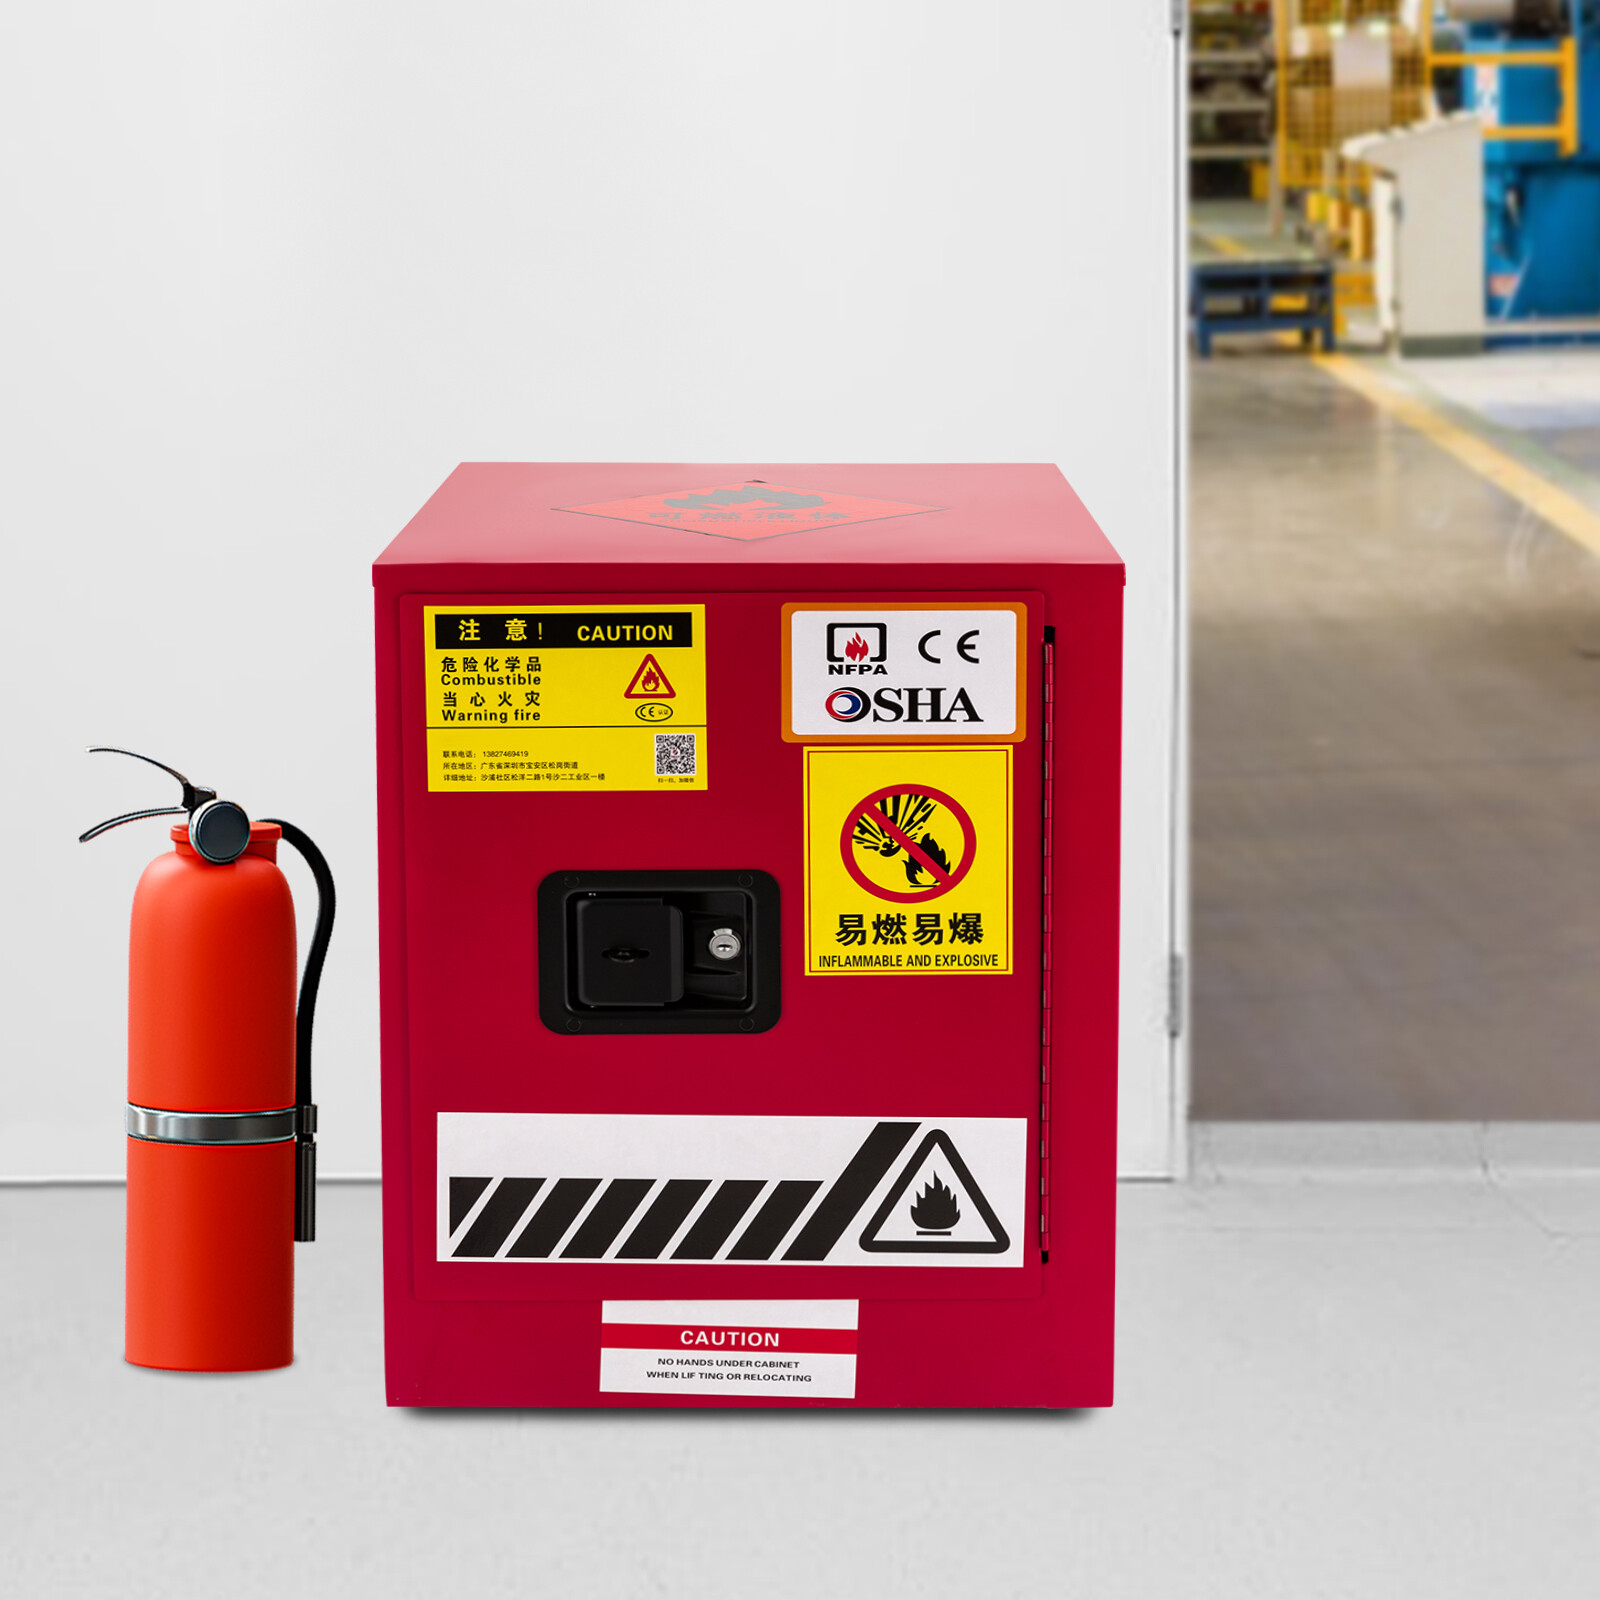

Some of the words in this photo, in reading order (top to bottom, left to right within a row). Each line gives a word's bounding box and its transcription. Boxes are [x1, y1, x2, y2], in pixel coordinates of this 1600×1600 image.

[577, 624, 673, 642] CAUTION
[918, 629, 980, 665] CE
[442, 656, 542, 672] 危险化学品
[828, 663, 888, 675] NFPA
[440, 673, 542, 686] Combustible
[443, 691, 541, 707] 当心火灾
[825, 686, 984, 722] OSHA
[442, 709, 508, 724] Warning
[514, 709, 541, 721] fire
[835, 912, 985, 947] 易燃易爆
[818, 954, 903, 968] INFLAMMABLE
[905, 954, 932, 967] AND
[935, 953, 999, 967] EXPLOSIVE
[680, 1329, 780, 1347] CAUTION
[657, 1357, 675, 1366] NO
[676, 1358, 714, 1367] HANDS
[715, 1359, 753, 1368] UNDER
[754, 1360, 800, 1369] CABINET
[646, 1370, 679, 1379] WHEN
[726, 1373, 742, 1381] OR
[743, 1373, 812, 1383] RELOCATING
